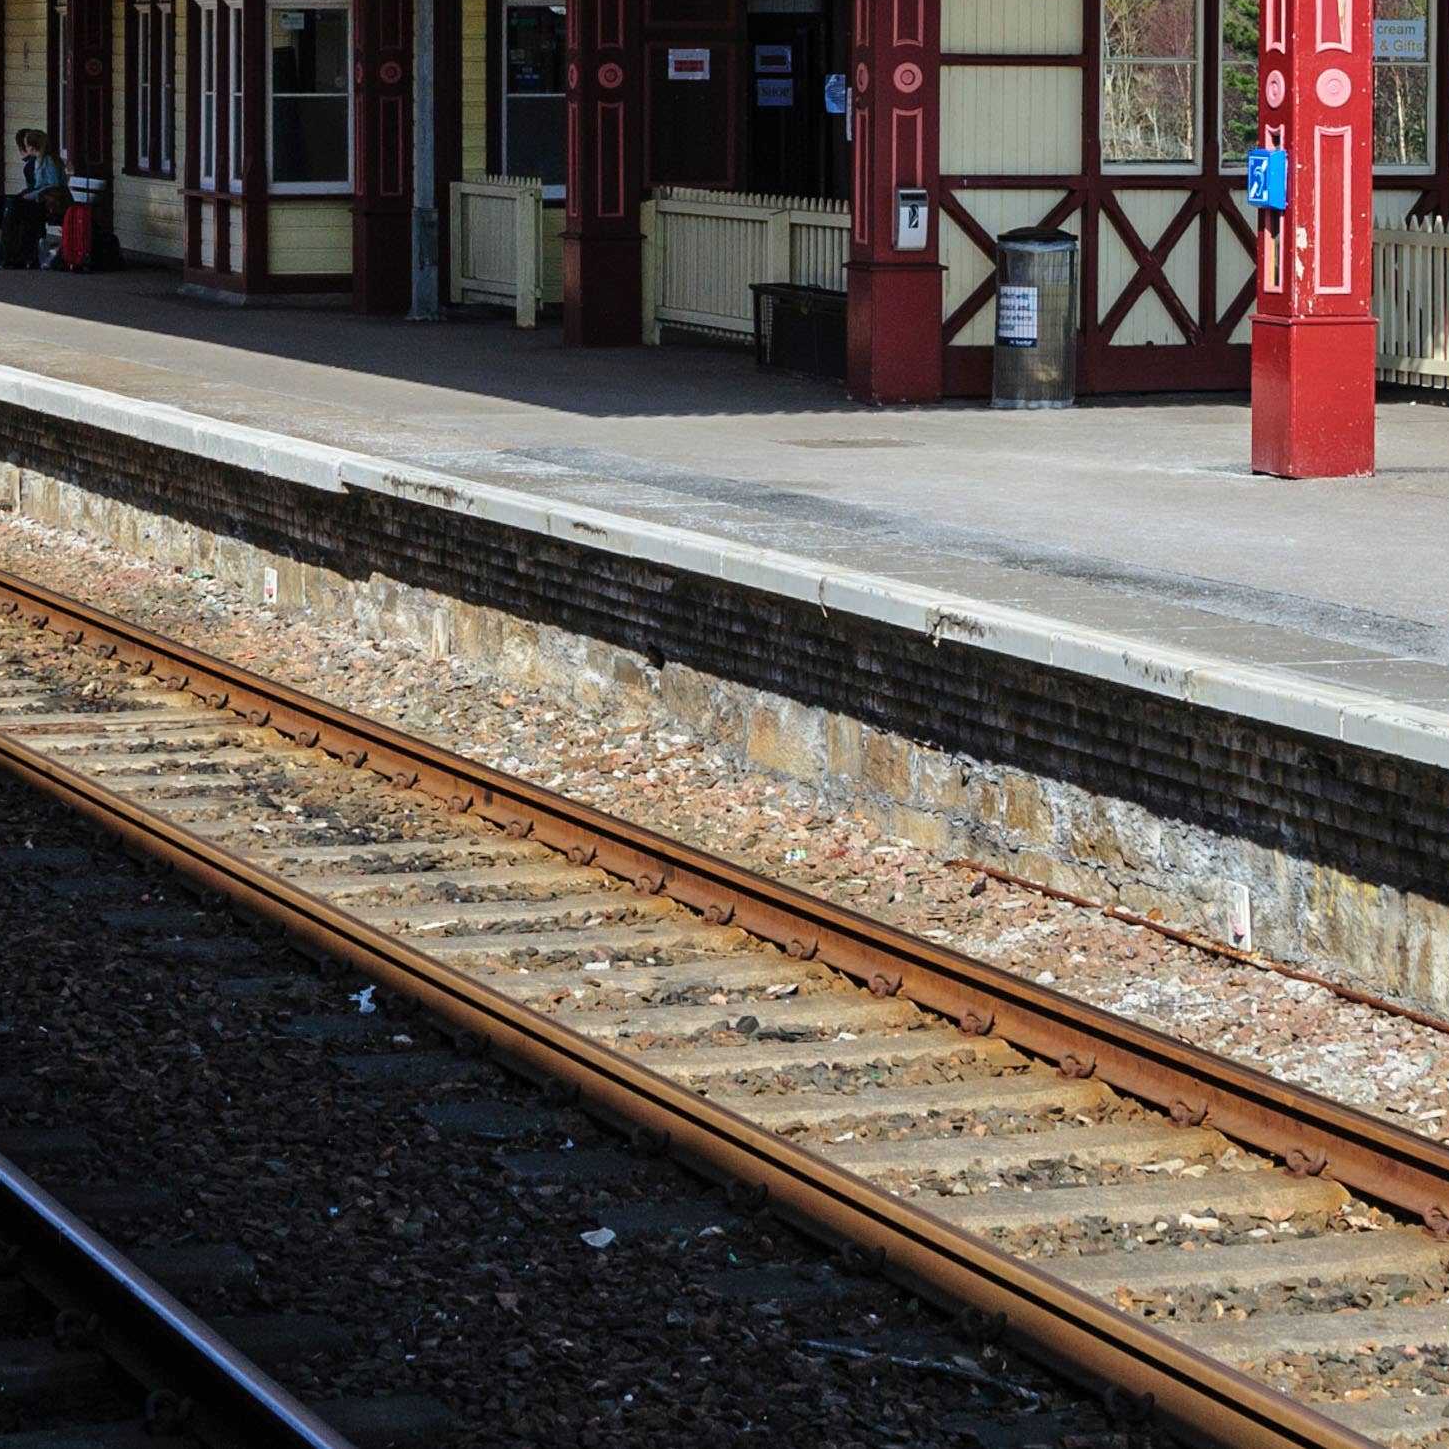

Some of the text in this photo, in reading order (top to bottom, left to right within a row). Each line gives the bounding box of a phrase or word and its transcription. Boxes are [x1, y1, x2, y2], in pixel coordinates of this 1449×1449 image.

[1376, 25, 1416, 35] cream
[1379, 39, 1423, 52] & Gifts
[761, 87, 791, 97] SHOP
